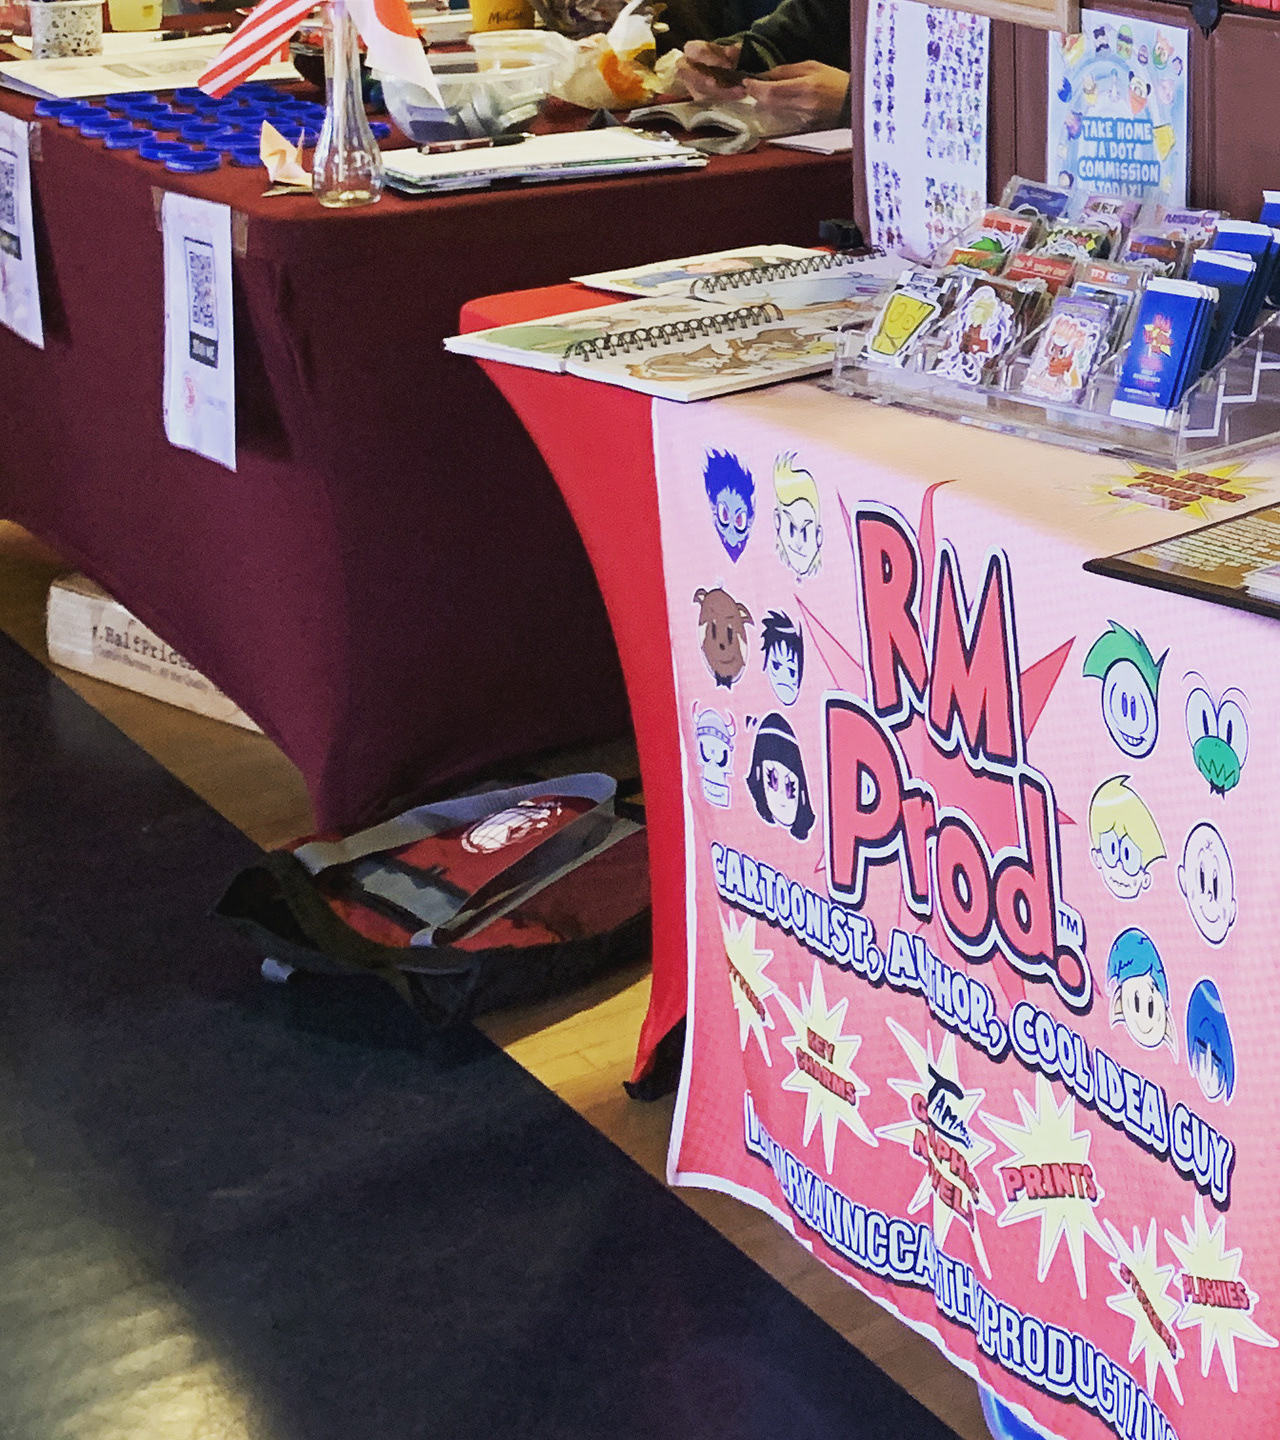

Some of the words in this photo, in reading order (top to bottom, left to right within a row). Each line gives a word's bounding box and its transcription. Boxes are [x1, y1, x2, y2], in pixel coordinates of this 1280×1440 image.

[1082, 120, 1113, 138] TAKE
[1117, 121, 1152, 140] HOME
[1098, 141, 1106, 159] A
[855, 500, 1018, 768] RM
[822, 690, 1092, 1015] Prod.
[711, 841, 886, 988] CARTOONIST,
[1010, 1000, 1095, 1106] COOL
[1094, 1047, 1171, 1159] IDEA
[1168, 1100, 1236, 1210] GUY
[806, 1026, 836, 1065] KEY
[1001, 1162, 1098, 1203] PRINTS
[1182, 1273, 1251, 1311] PLUSHIES
